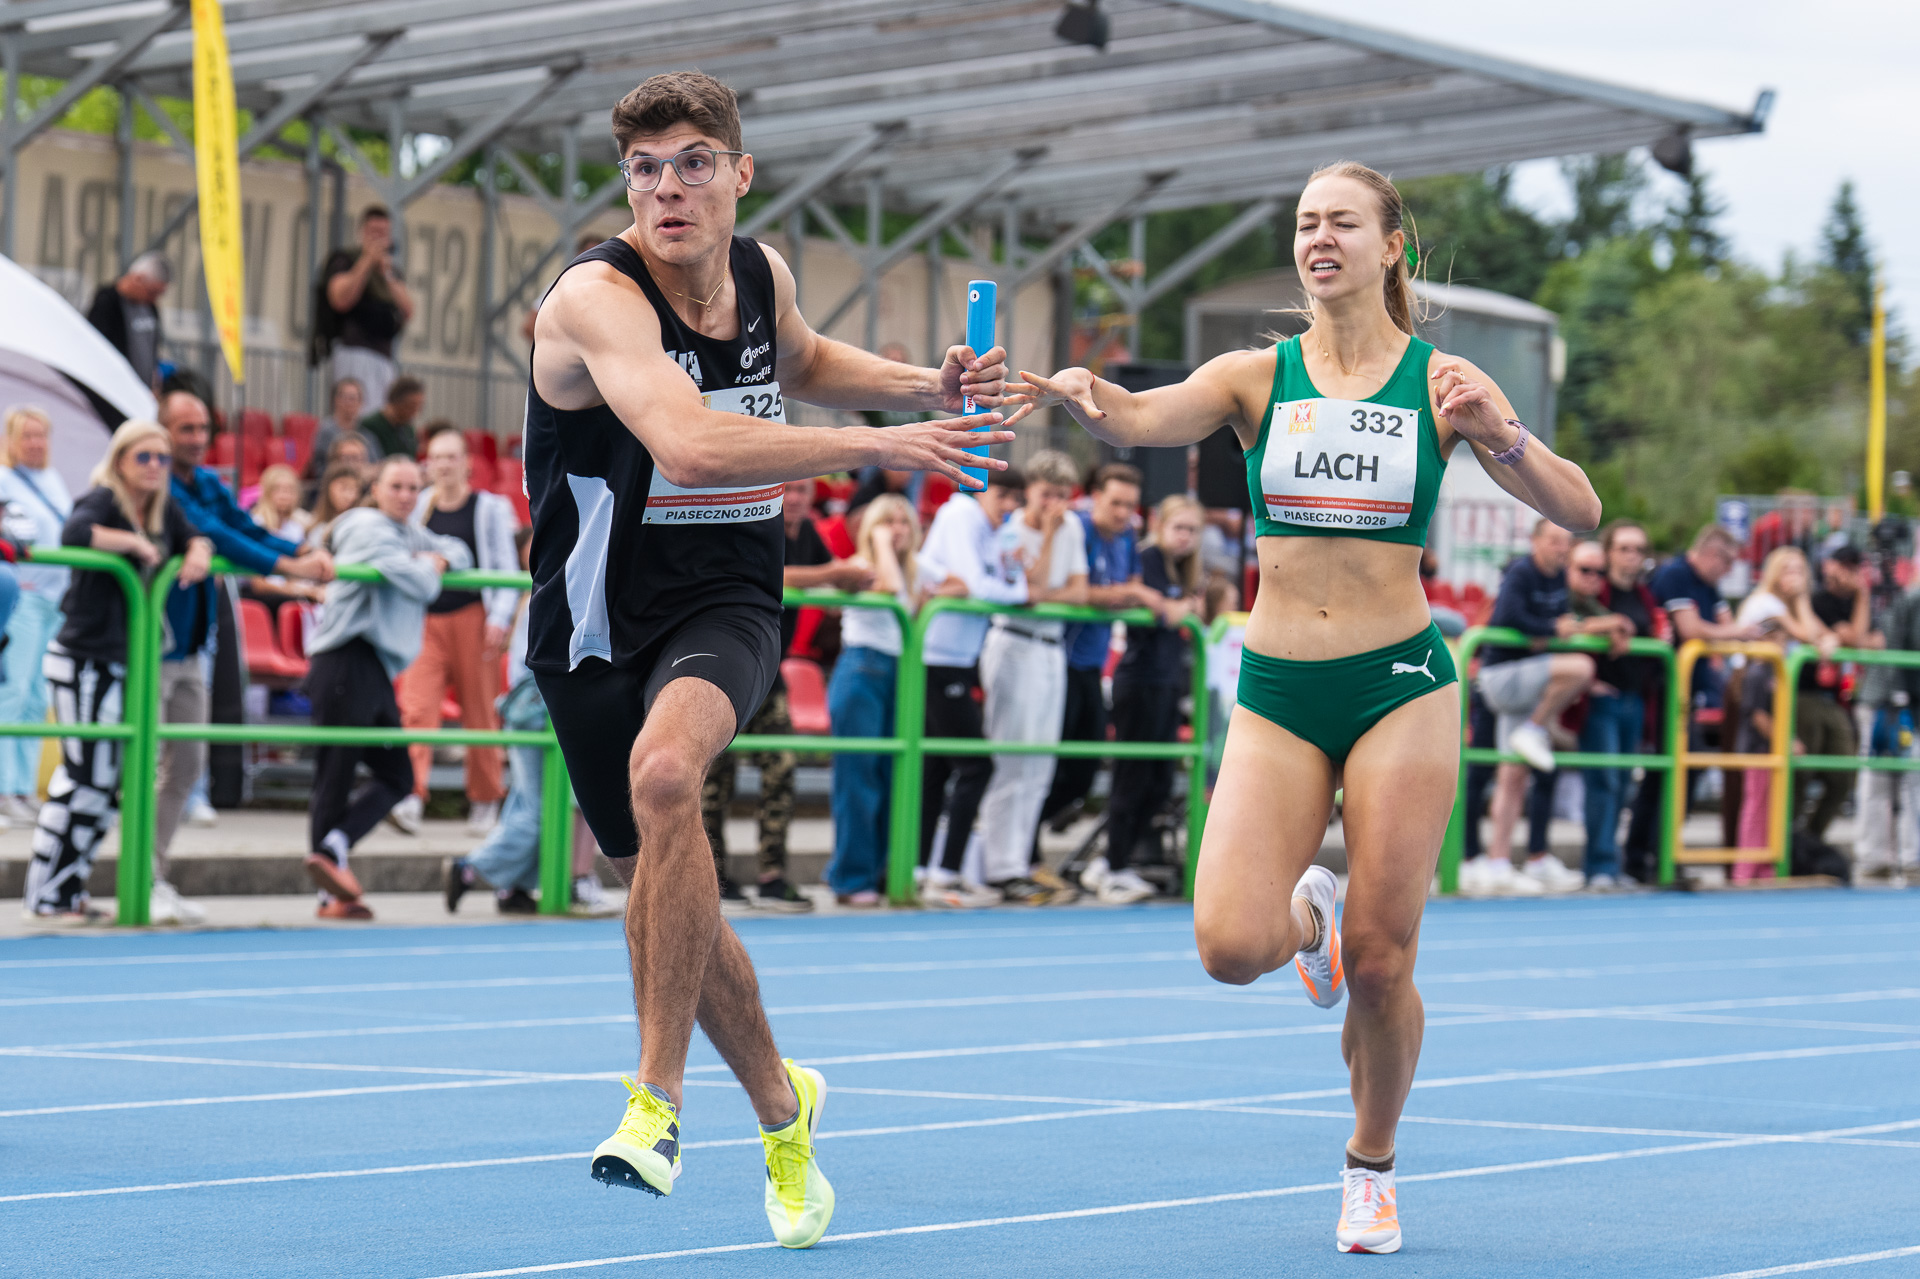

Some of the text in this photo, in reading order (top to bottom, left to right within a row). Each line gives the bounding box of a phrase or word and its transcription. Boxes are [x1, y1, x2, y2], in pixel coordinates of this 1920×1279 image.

[752, 341, 770, 359] OPOLE
[740, 390, 783, 419] 325
[1350, 409, 1403, 438] 332
[1295, 451, 1379, 482] LACH
[665, 504, 771, 520] PIASECZNO 2026
[1284, 511, 1387, 526] PIASECZNO 2026
